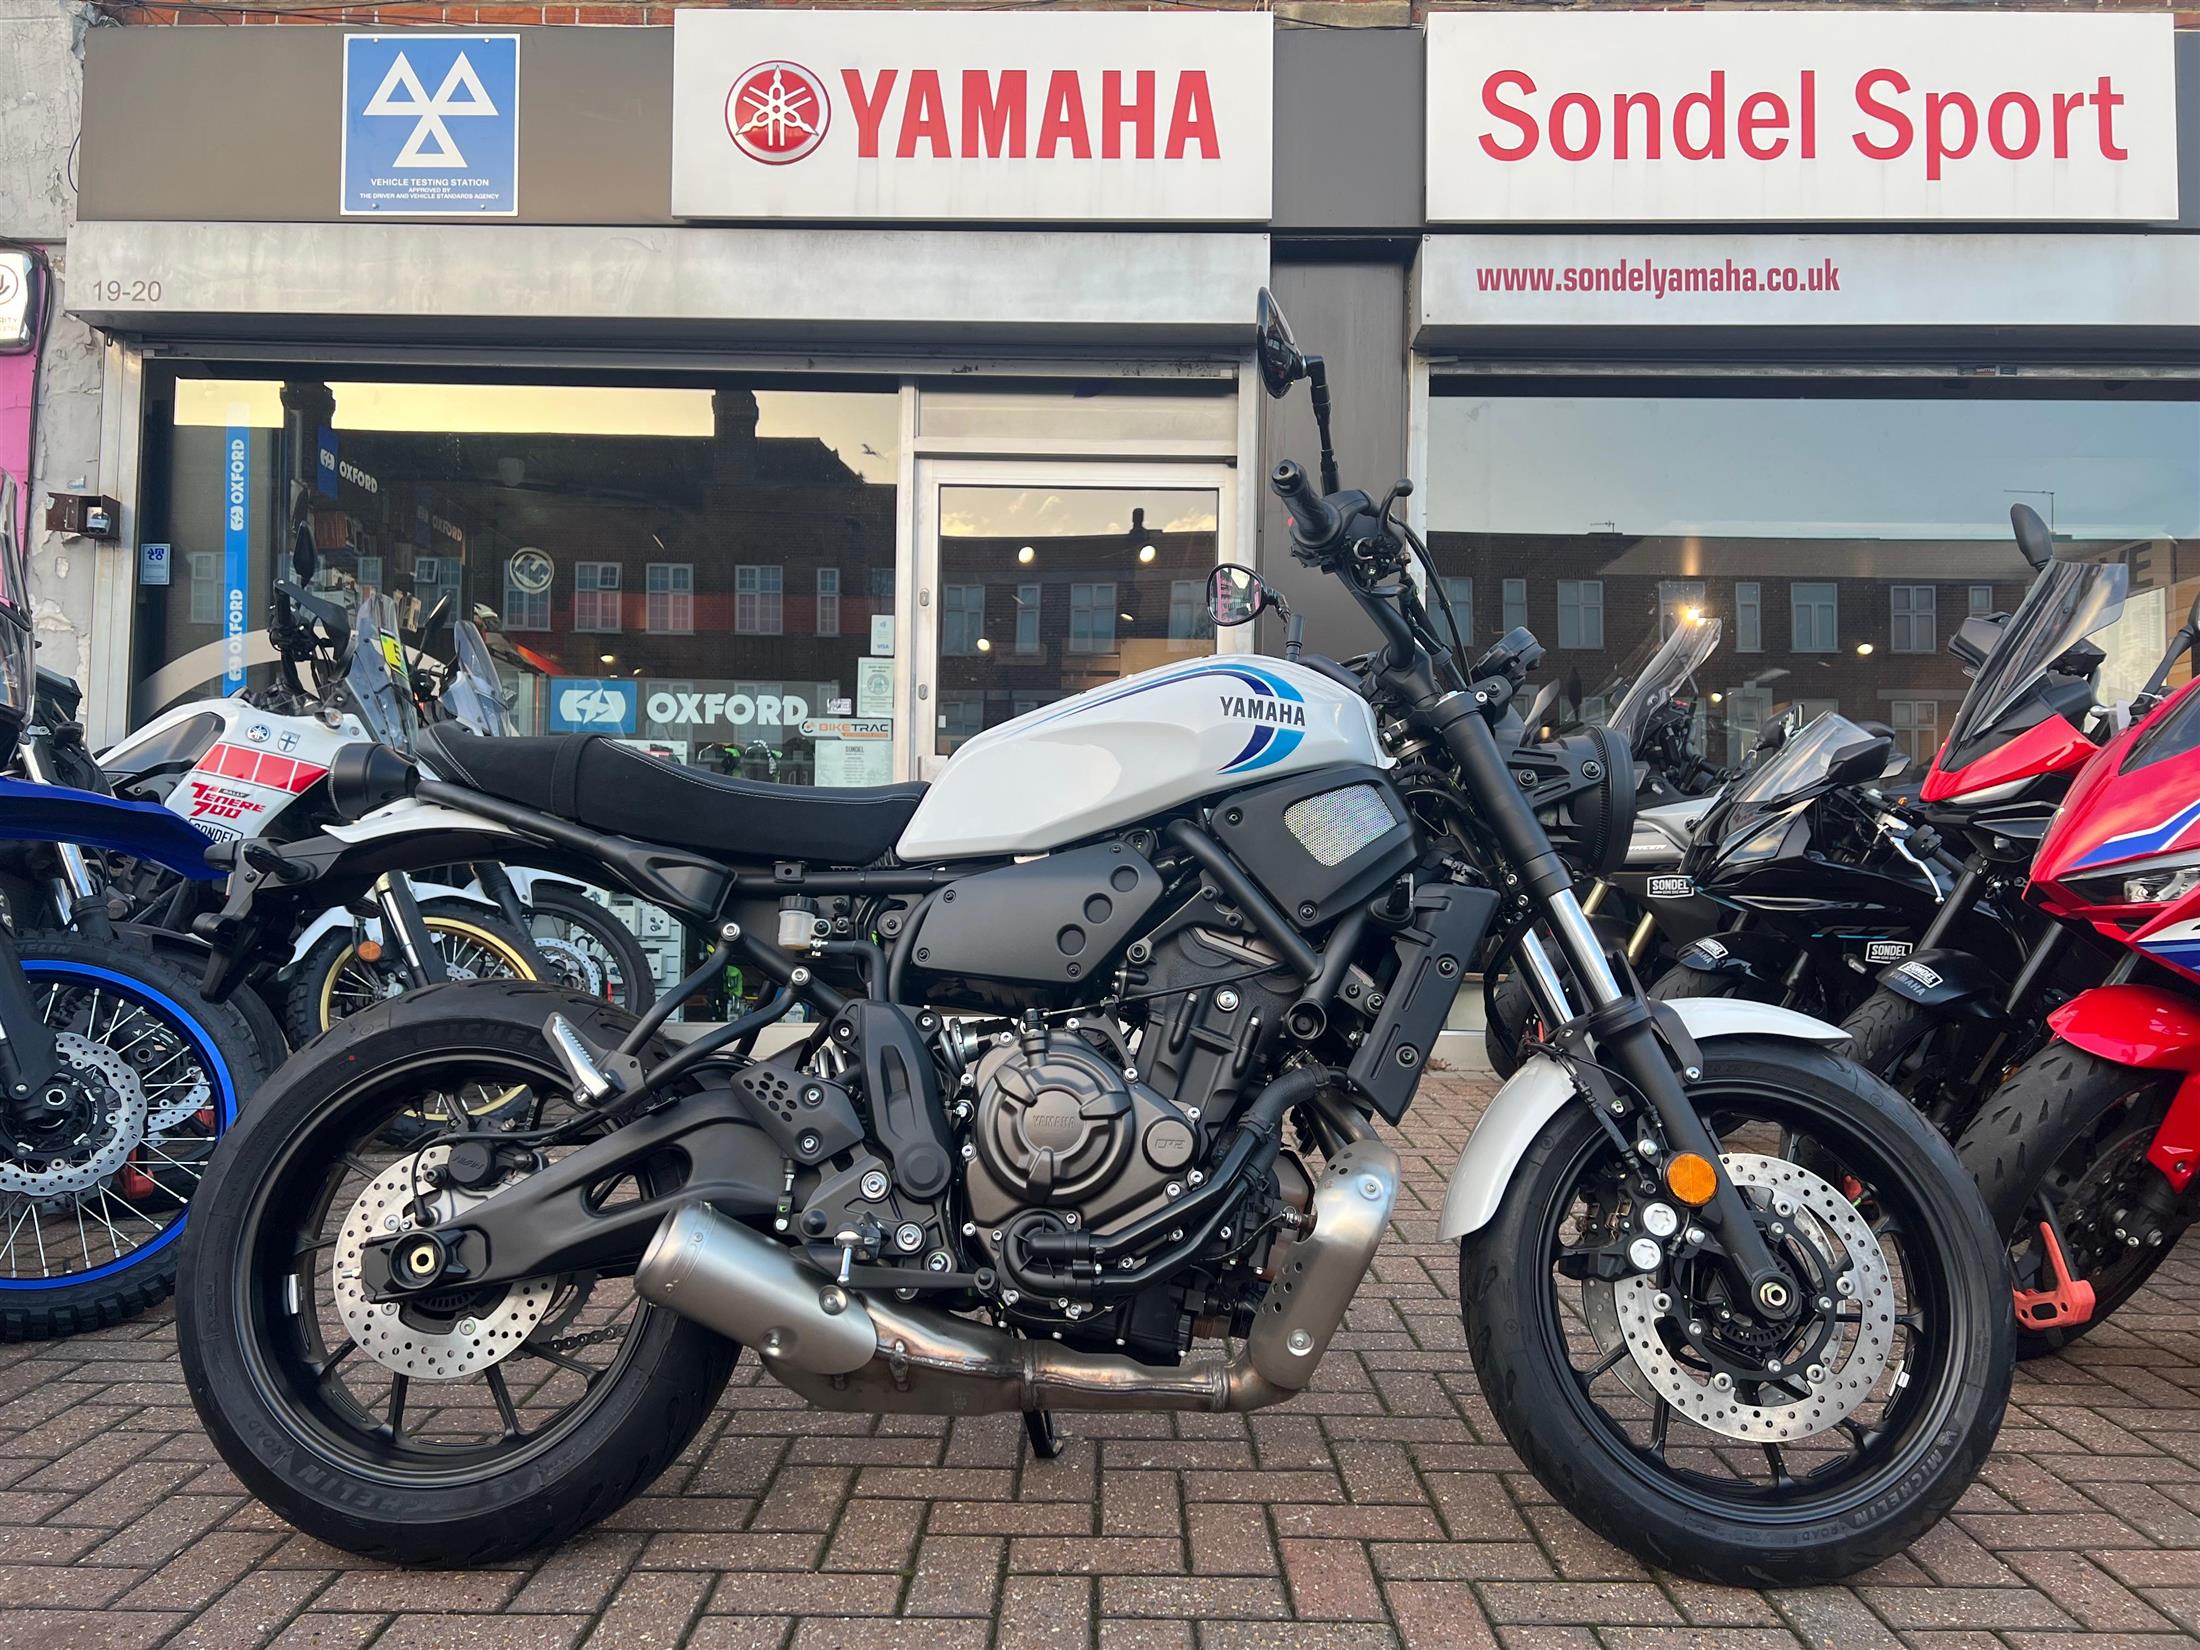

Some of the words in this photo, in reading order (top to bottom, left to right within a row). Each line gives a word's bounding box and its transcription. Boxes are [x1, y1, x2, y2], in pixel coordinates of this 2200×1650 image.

[840, 69, 1221, 159] YAMAHA
[1478, 70, 1816, 161] Sondel
[1852, 68, 2129, 181] Sport
[370, 178, 408, 187] VEHICLE
[411, 178, 449, 187] TESTING
[451, 178, 489, 187] STATION
[93, 280, 161, 302] 19-20
[1476, 258, 1841, 299] www.sondelyamaha.co.uk
[231, 439, 245, 504] OXFORD
[339, 460, 378, 494] OXFORD
[432, 515, 463, 542] OXFORD
[229, 589, 243, 654] OXFORD
[646, 692, 809, 726] OXFORD
[1219, 696, 1306, 727] YAMAHA
[818, 723, 889, 732] BIKETRAC
[190, 801, 242, 819] 700
[1652, 879, 1690, 890] SONDEL
[1871, 945, 1907, 956] SONDEL
[1887, 971, 1927, 996] YAMAHA
[1903, 963, 1937, 983] SONDEL
[1032, 1114, 1076, 1129] YAMAHA
[1854, 1448, 1944, 1526] MICHELIN
[1802, 1527, 1844, 1542] ROAD
